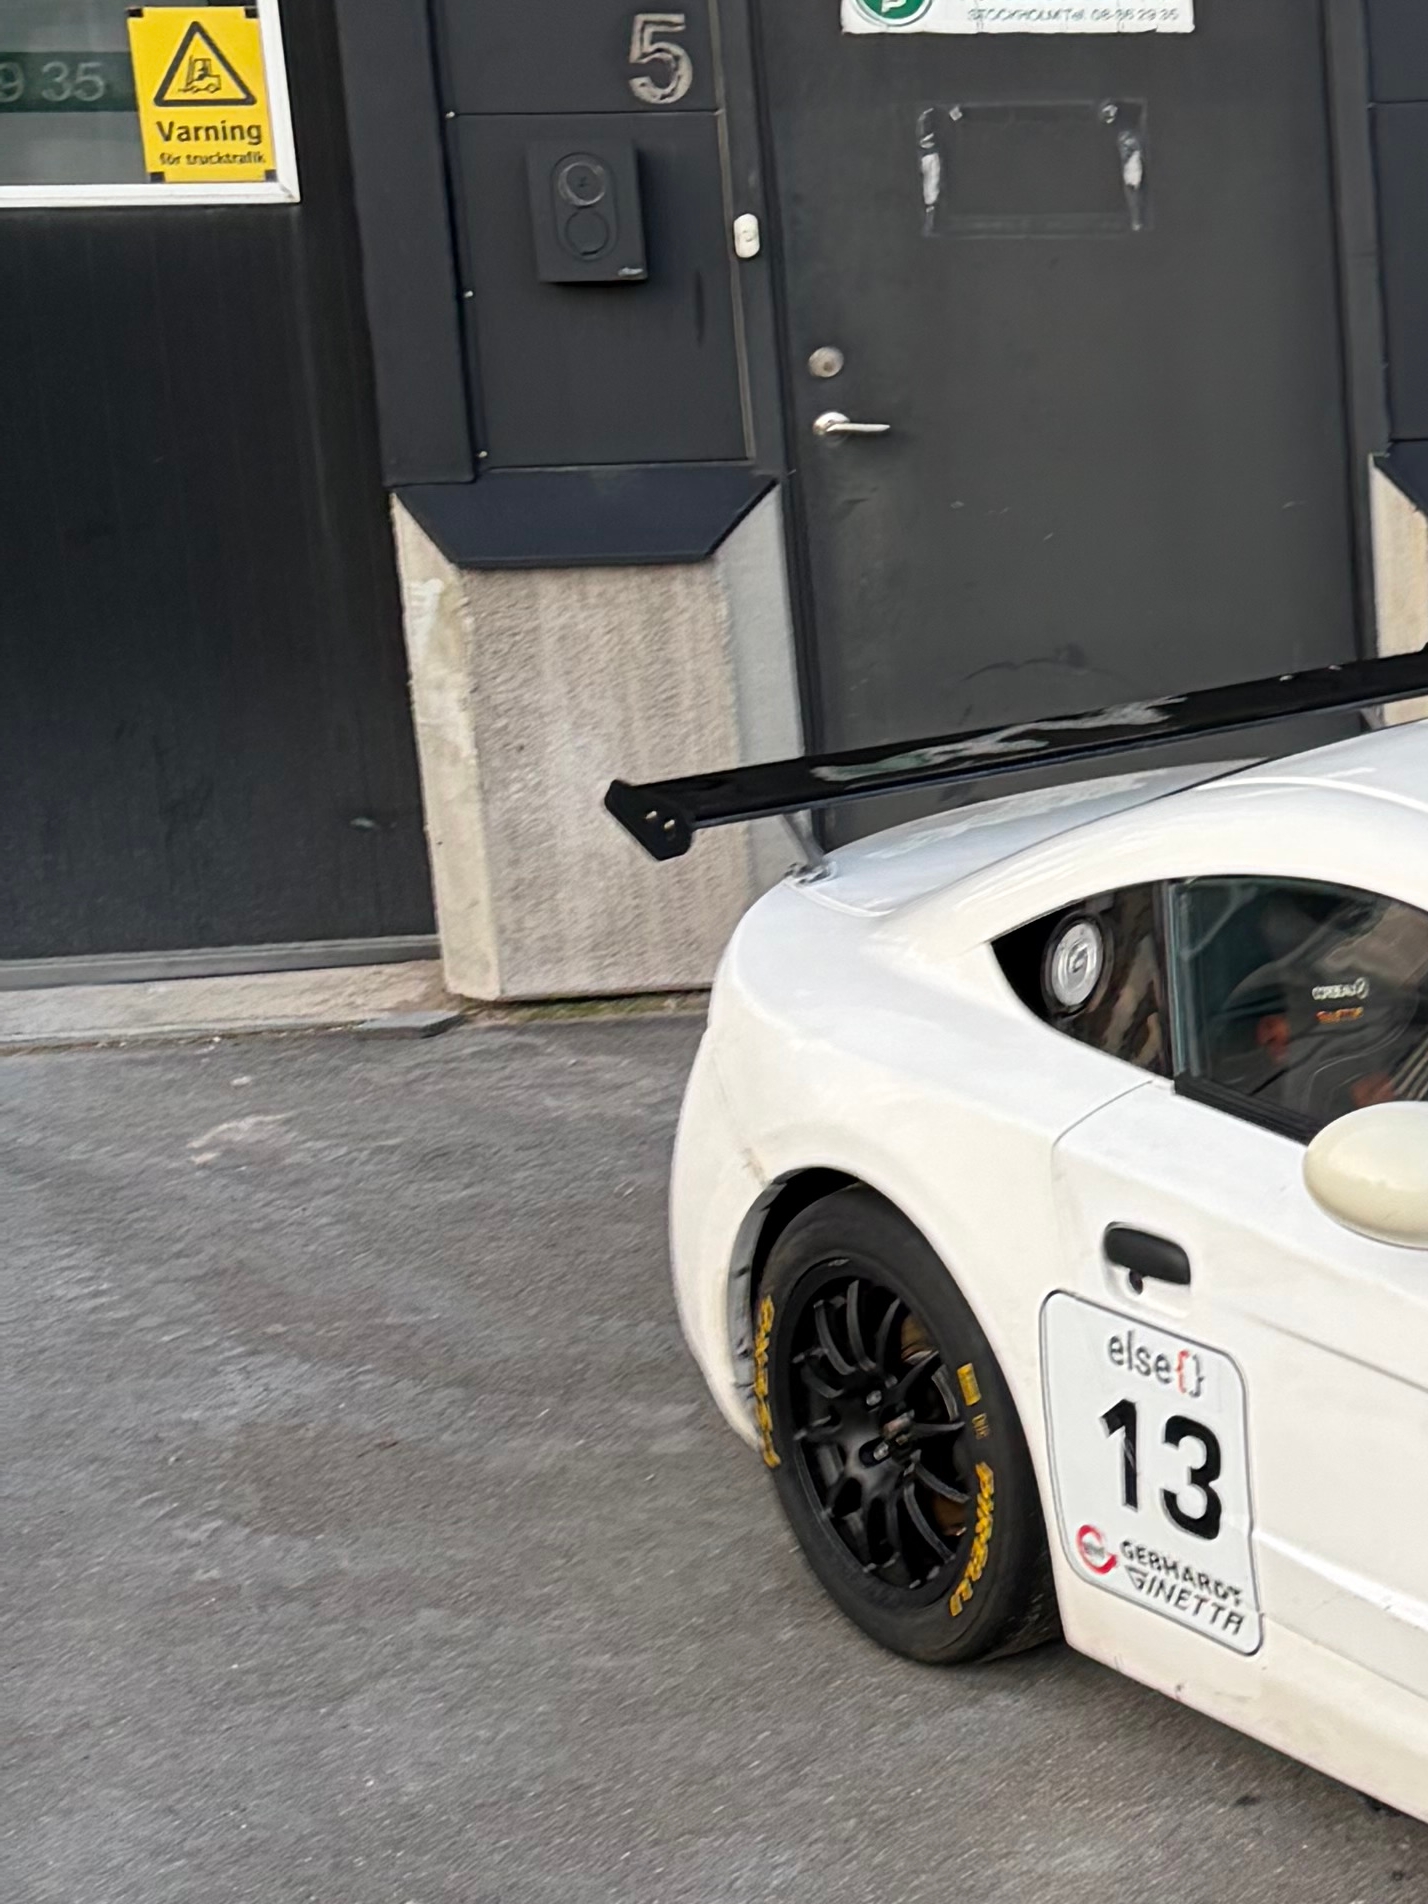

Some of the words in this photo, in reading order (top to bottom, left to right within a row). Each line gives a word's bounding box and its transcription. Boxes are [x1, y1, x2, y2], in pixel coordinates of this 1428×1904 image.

[41, 60, 106, 103] 35
[627, 13, 694, 105] 5
[156, 119, 263, 146] Varning
[186, 151, 266, 166] trucktrafik
[1098, 1399, 1223, 1541] 13
[1119, 1539, 1243, 1607] GEBHARDT
[1123, 1564, 1246, 1637] GINETTA
